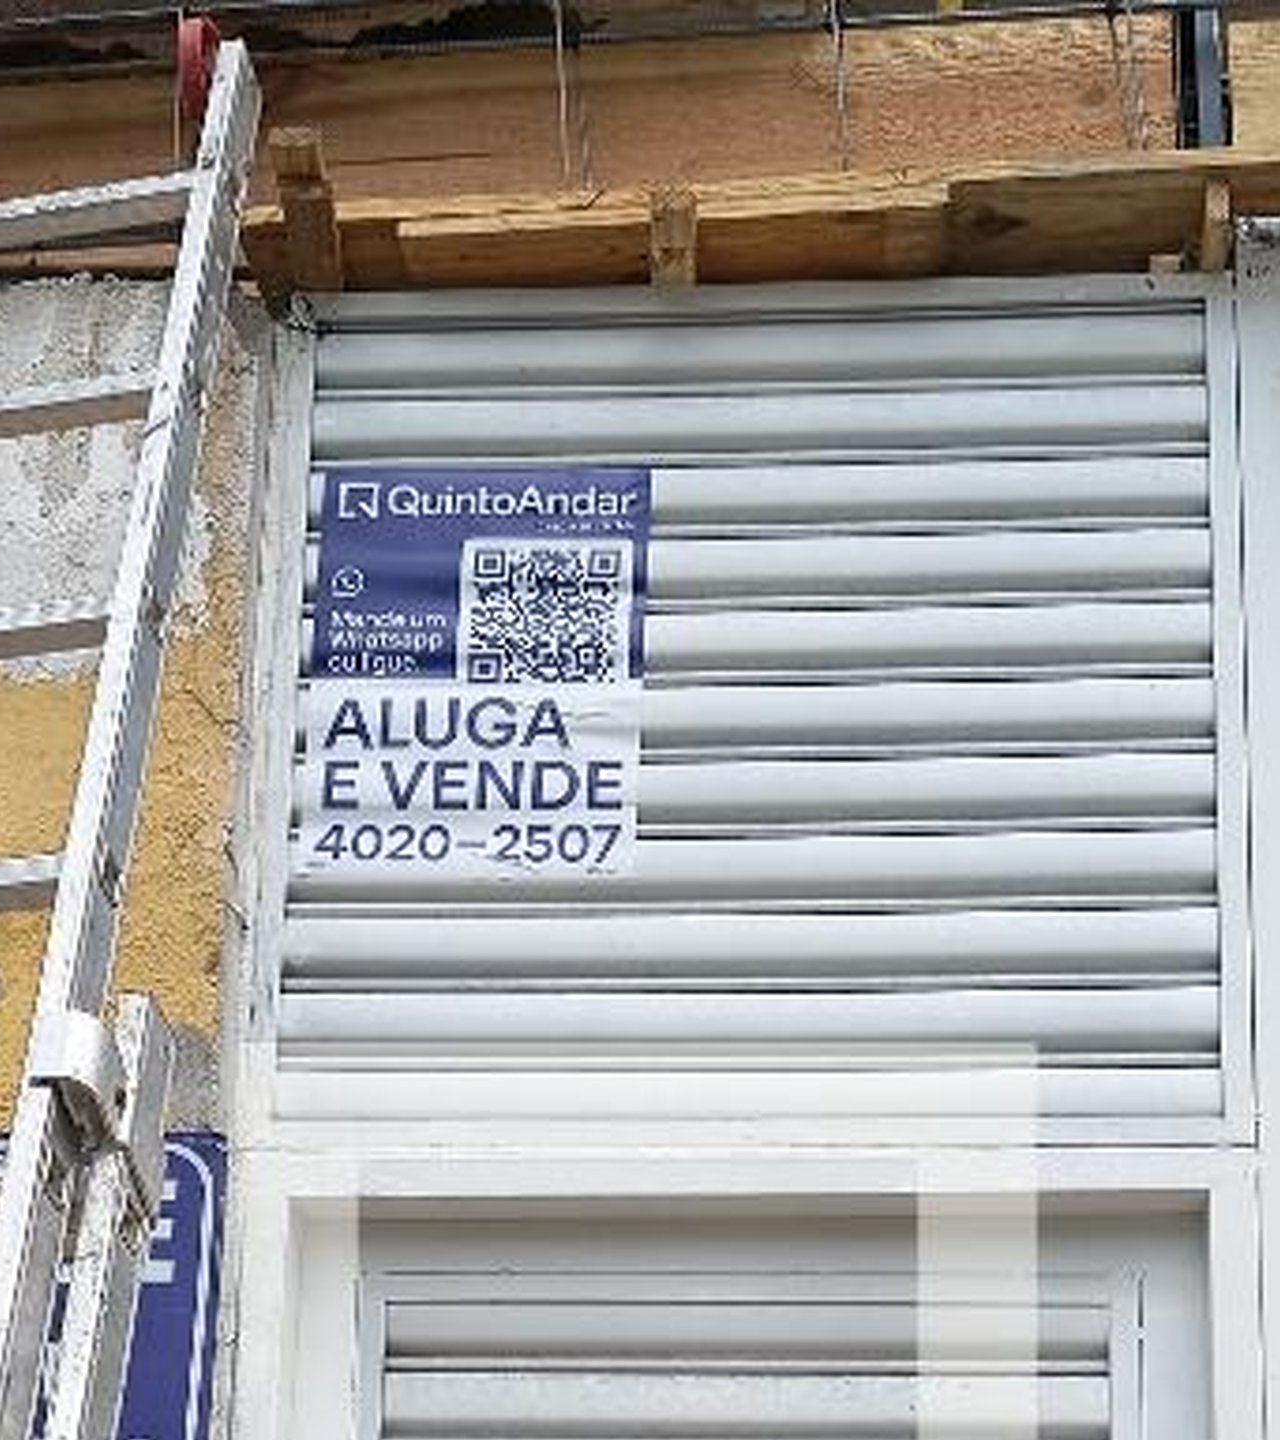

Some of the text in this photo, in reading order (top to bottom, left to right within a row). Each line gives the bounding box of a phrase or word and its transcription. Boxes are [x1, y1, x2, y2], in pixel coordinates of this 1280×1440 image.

[386, 484, 638, 518] QuintoAndar
[410, 613, 447, 627] um
[323, 696, 572, 750] ALUGA
[322, 760, 623, 811] E VENDE
[314, 823, 622, 863] 4020-2507
